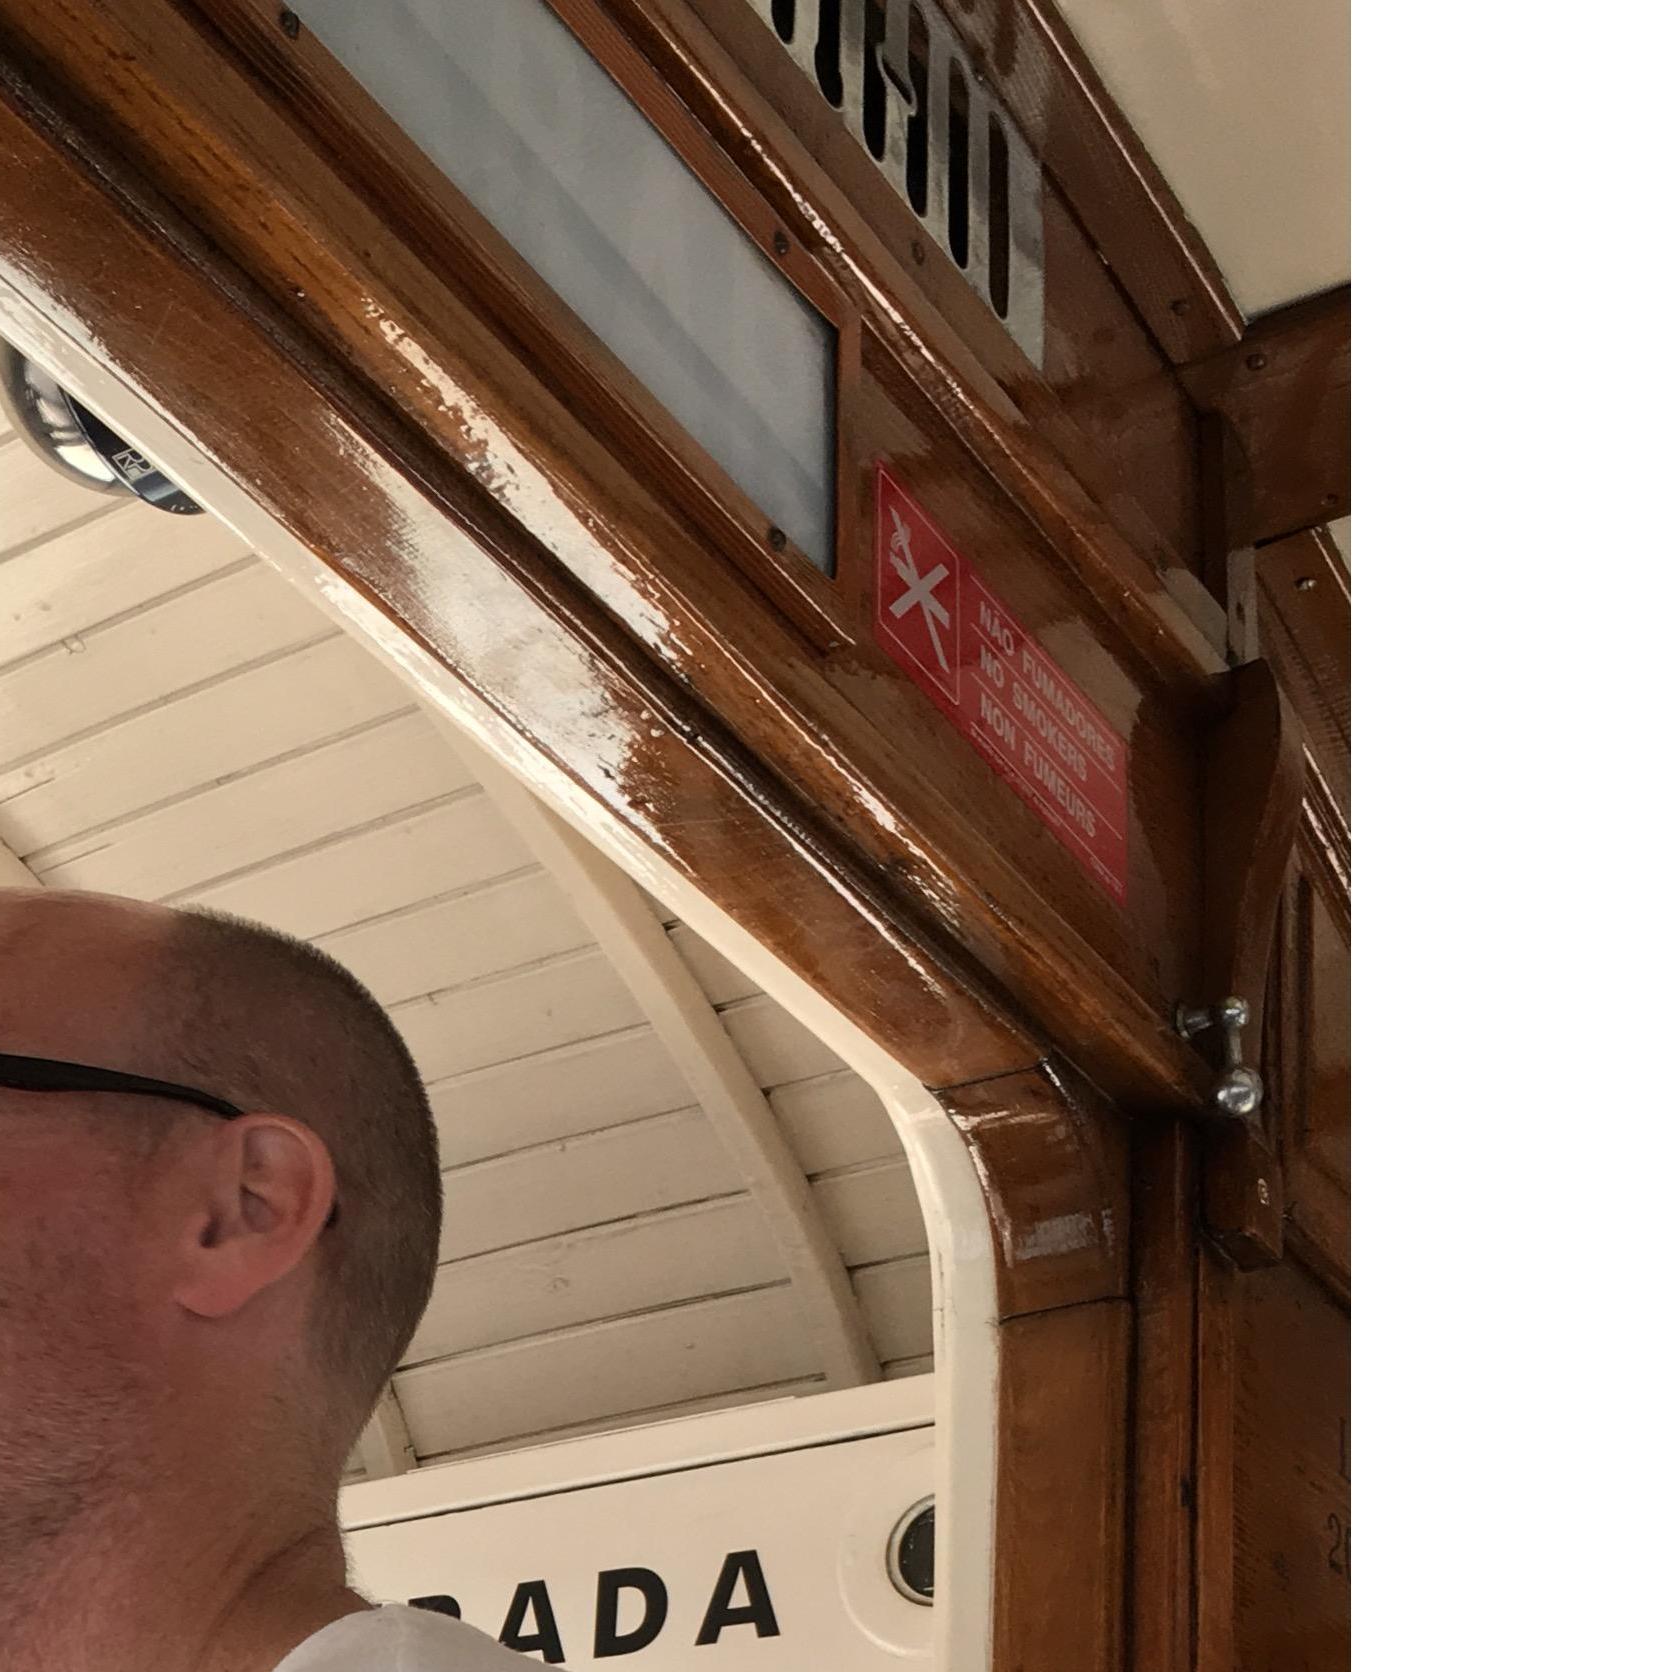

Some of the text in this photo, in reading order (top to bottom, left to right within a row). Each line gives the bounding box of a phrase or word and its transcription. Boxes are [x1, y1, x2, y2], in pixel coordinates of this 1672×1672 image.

[980, 600, 1115, 771] NÃO FUMADORES
[980, 643, 1005, 689] NO
[1012, 681, 1087, 781] SMOKERS
[980, 693, 1016, 751] NON
[1023, 740, 1096, 838] FUMEURS
